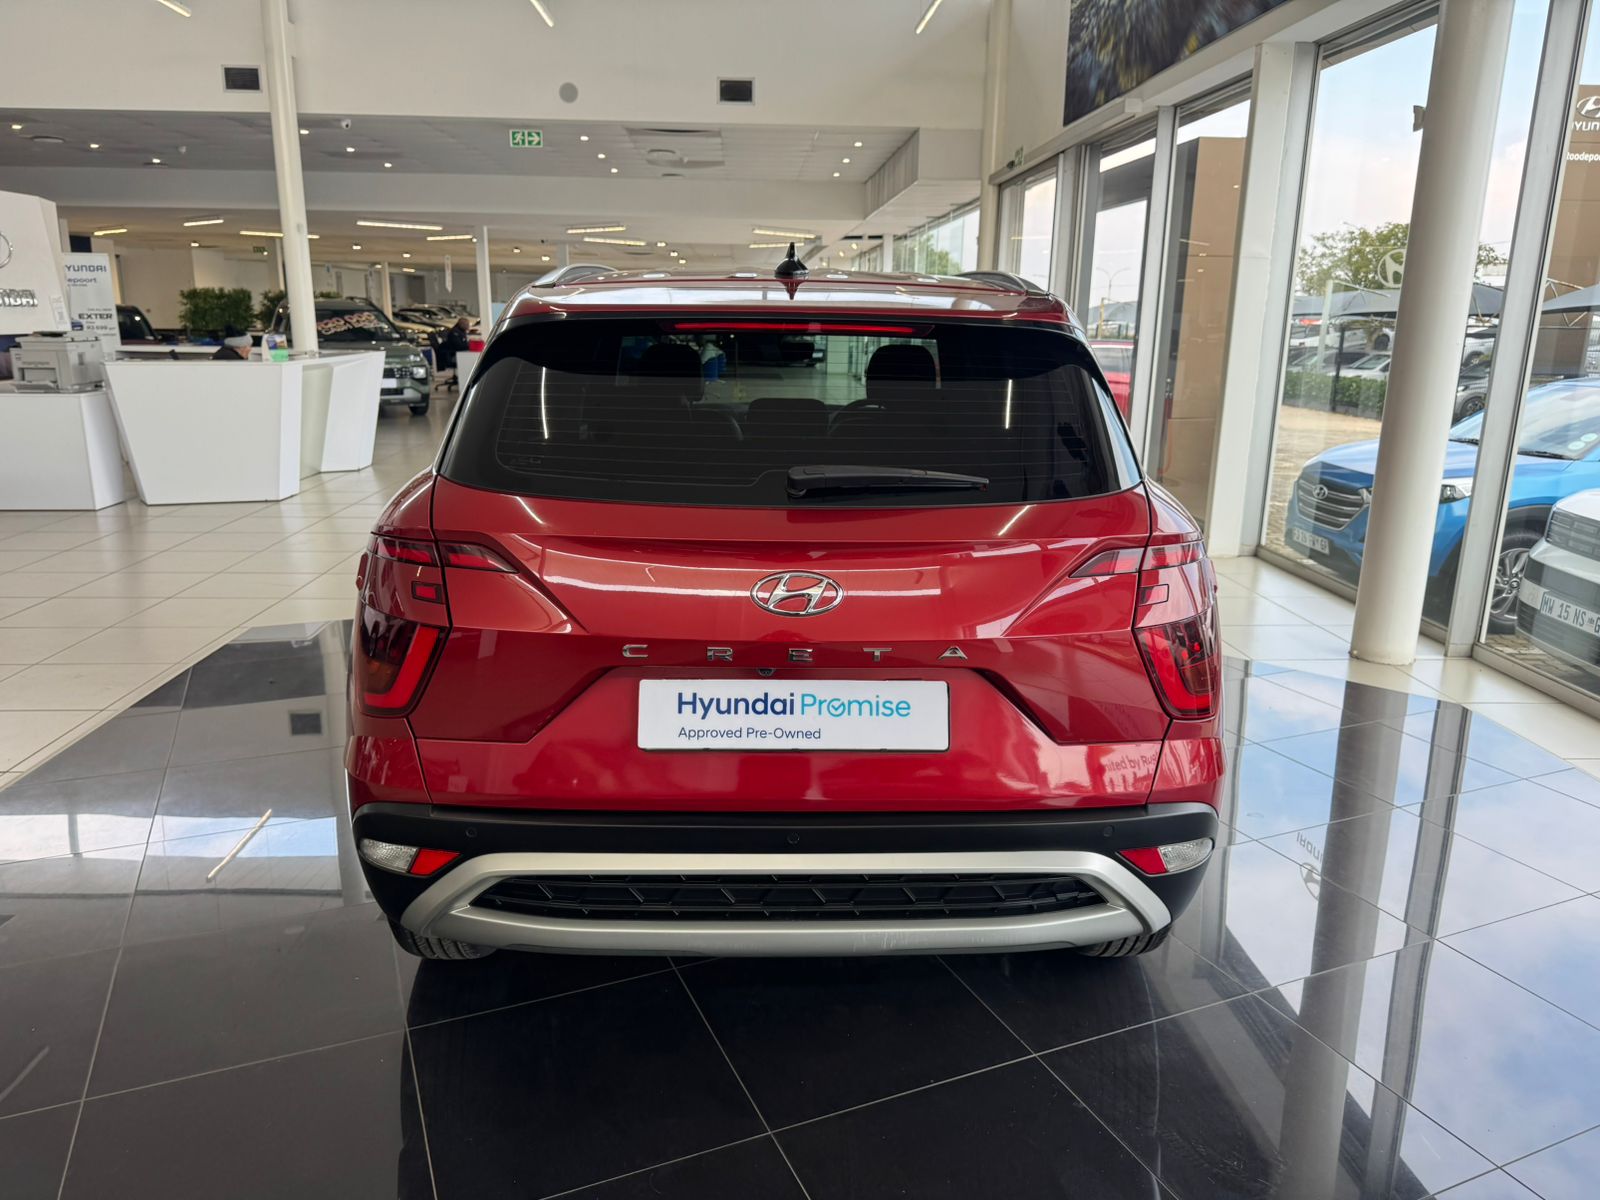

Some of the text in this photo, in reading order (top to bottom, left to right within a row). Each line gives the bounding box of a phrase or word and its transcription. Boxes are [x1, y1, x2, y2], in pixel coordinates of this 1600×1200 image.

[622, 643, 968, 662] CRETA
[677, 692, 912, 720] Hyundai Promise
[678, 726, 822, 741] Approved Pre-Owned
